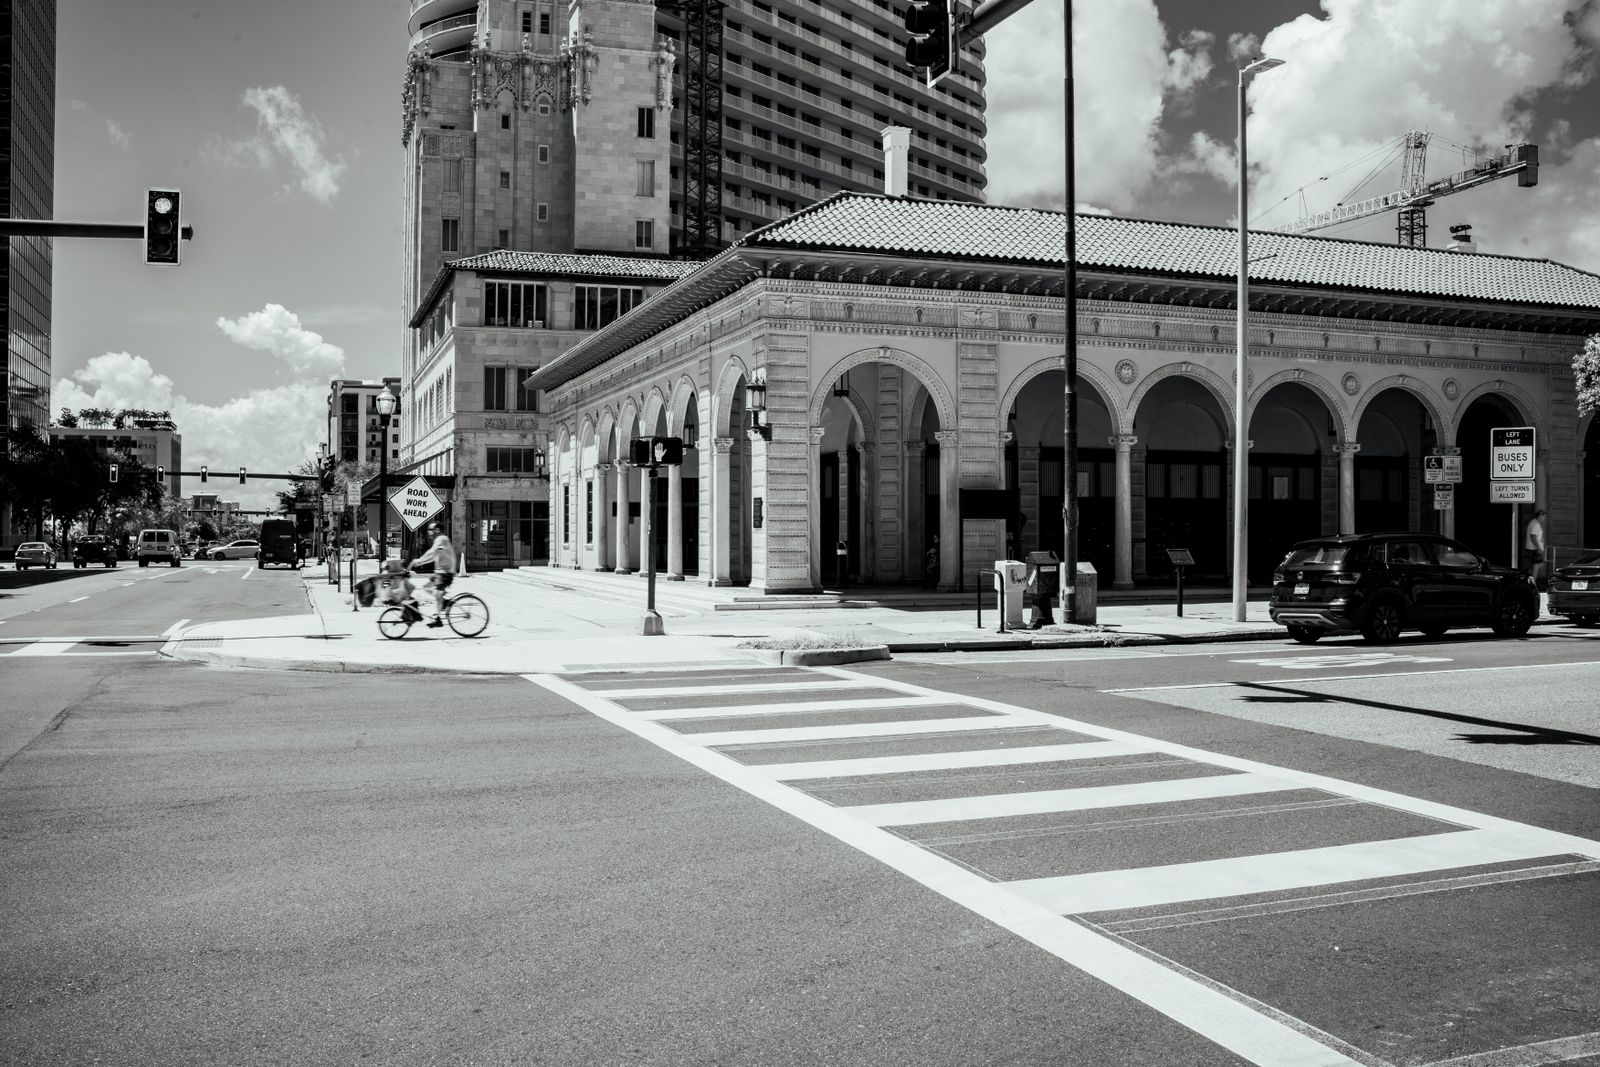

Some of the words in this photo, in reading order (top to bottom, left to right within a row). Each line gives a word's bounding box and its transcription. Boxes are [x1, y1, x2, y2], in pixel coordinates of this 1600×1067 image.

[1498, 453, 1527, 462] BUSES
[1501, 464, 1524, 472] ONLY
[407, 488, 429, 498] ROAD
[406, 498, 427, 508] WORK
[403, 509, 428, 518] AHEAD
